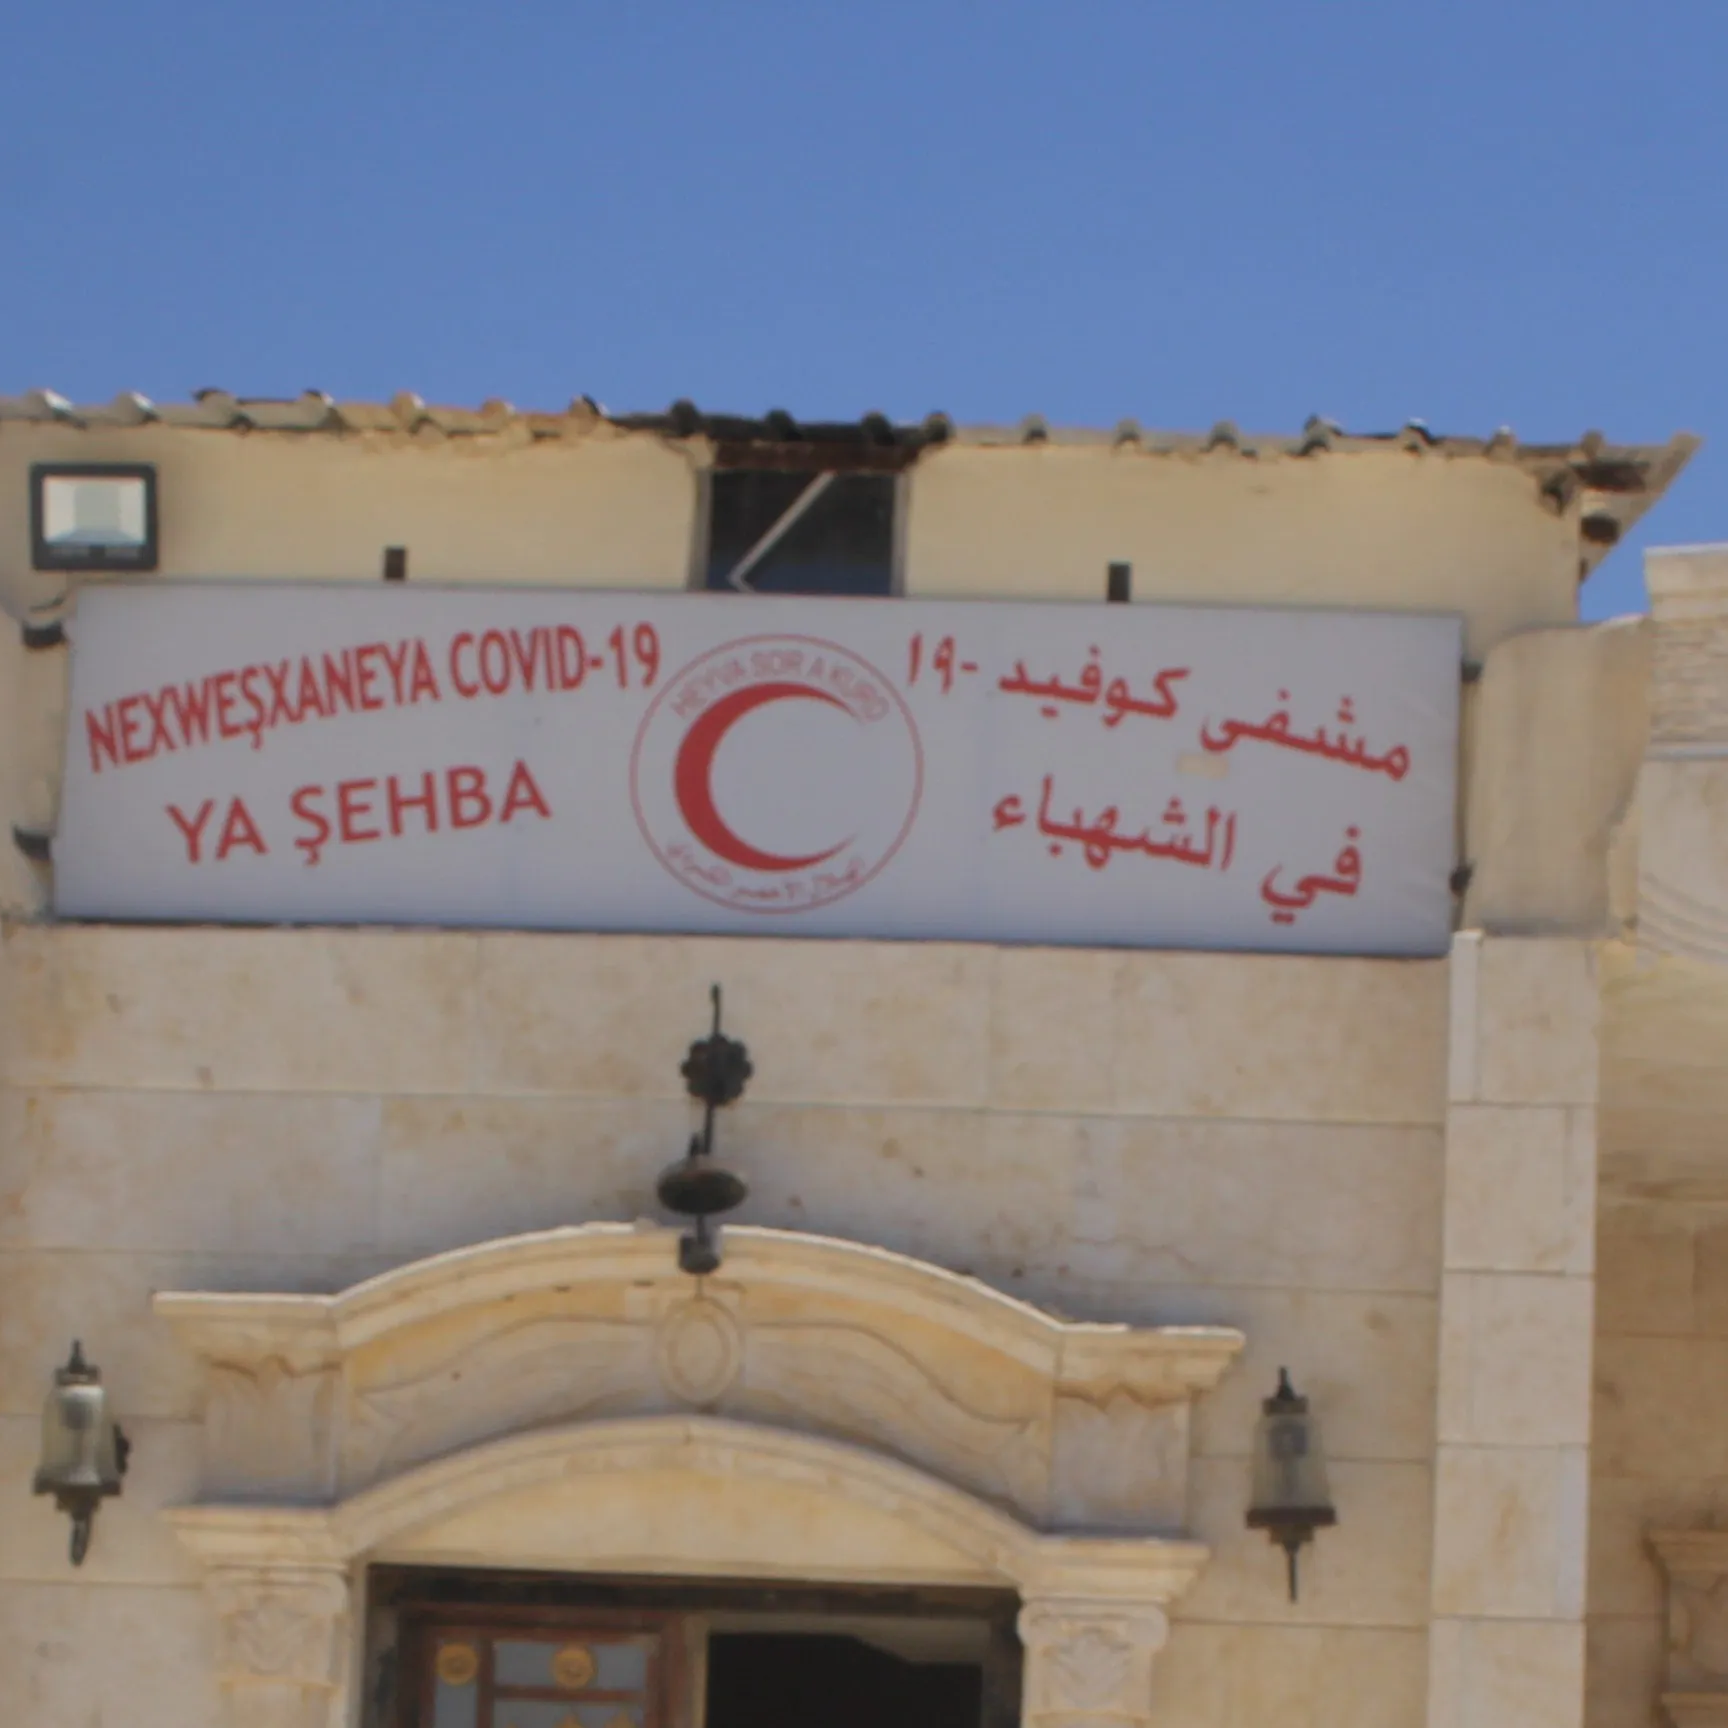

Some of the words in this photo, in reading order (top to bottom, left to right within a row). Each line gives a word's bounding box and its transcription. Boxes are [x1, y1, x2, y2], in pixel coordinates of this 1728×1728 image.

[84, 639, 442, 774] NEXWEŞXANEYA
[449, 622, 661, 698] COVID-19
[998, 646, 1192, 730] كوفيد
[1198, 688, 1412, 783] مشفى
[165, 797, 271, 864] YA
[289, 759, 554, 867] ŞEHBA
[992, 775, 1238, 872] الشهباء
[1258, 825, 1364, 925] في
